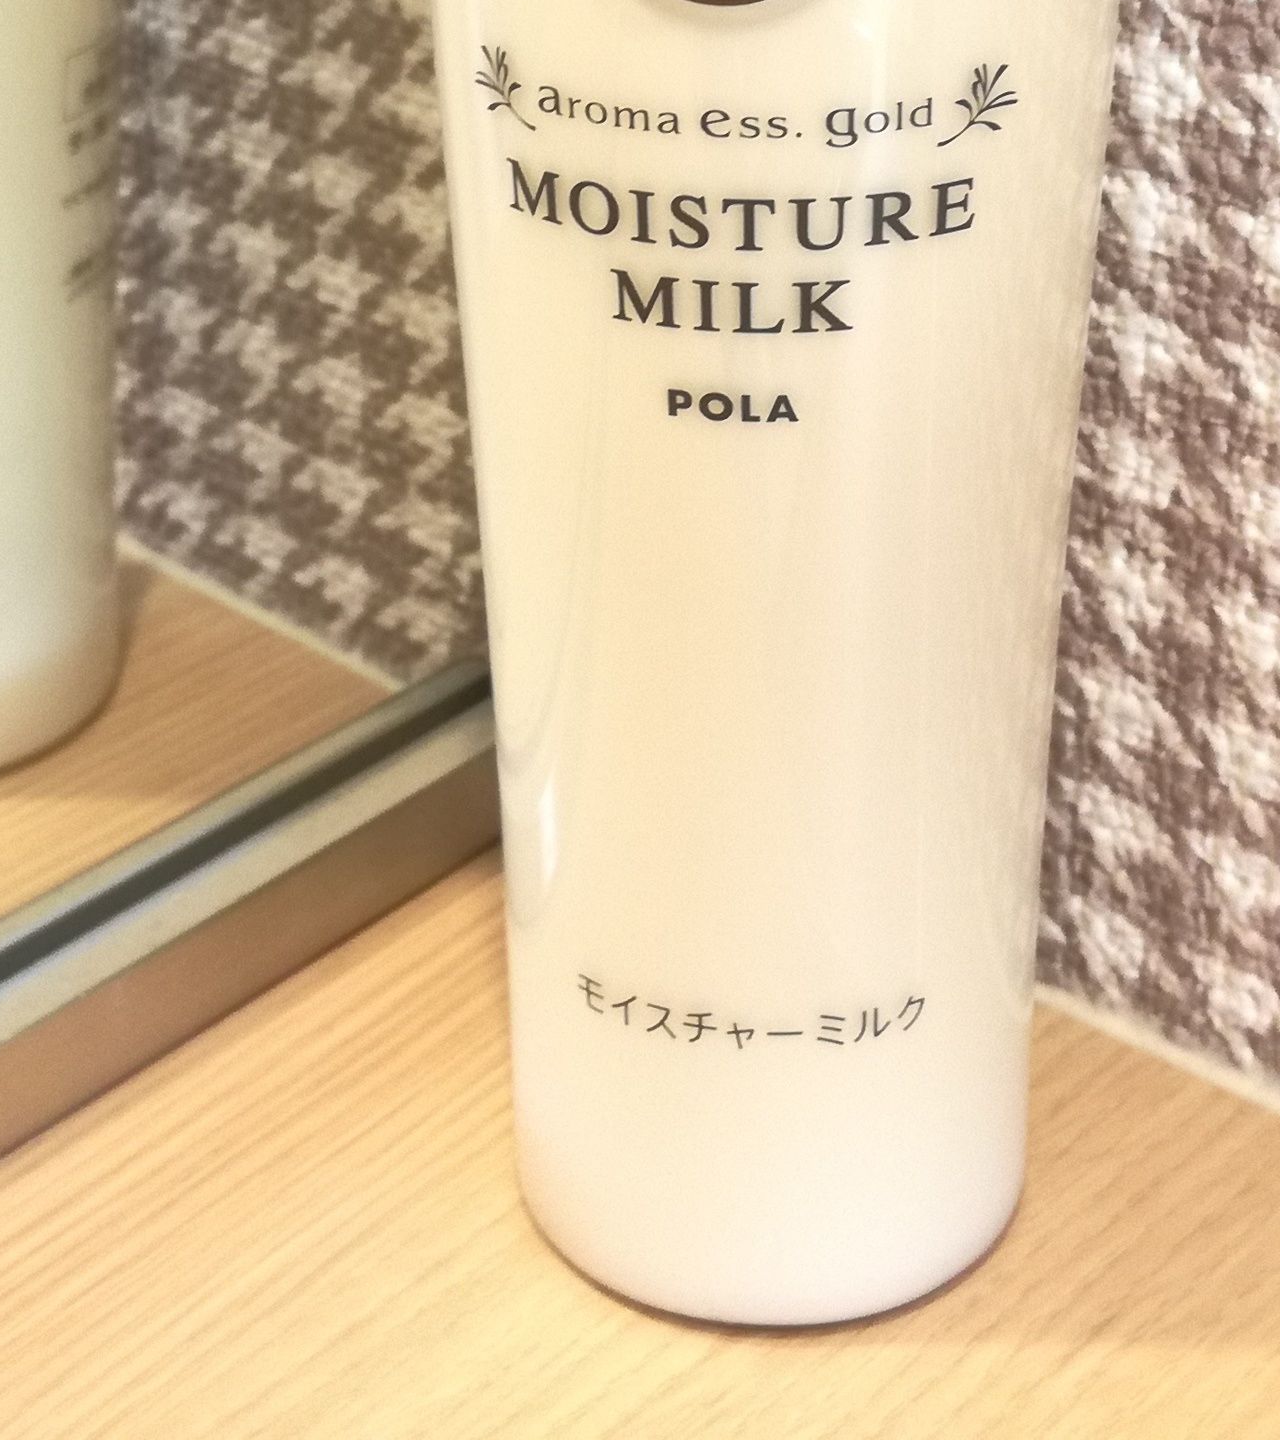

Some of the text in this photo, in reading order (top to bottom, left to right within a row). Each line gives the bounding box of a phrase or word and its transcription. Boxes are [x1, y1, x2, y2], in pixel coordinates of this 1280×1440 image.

[537, 85, 933, 149] aroma ess. gold
[505, 157, 976, 252] MOISTURE
[609, 267, 854, 335] MILK
[666, 387, 800, 424] POLA
[577, 973, 926, 1049] モイスチャーミルク
